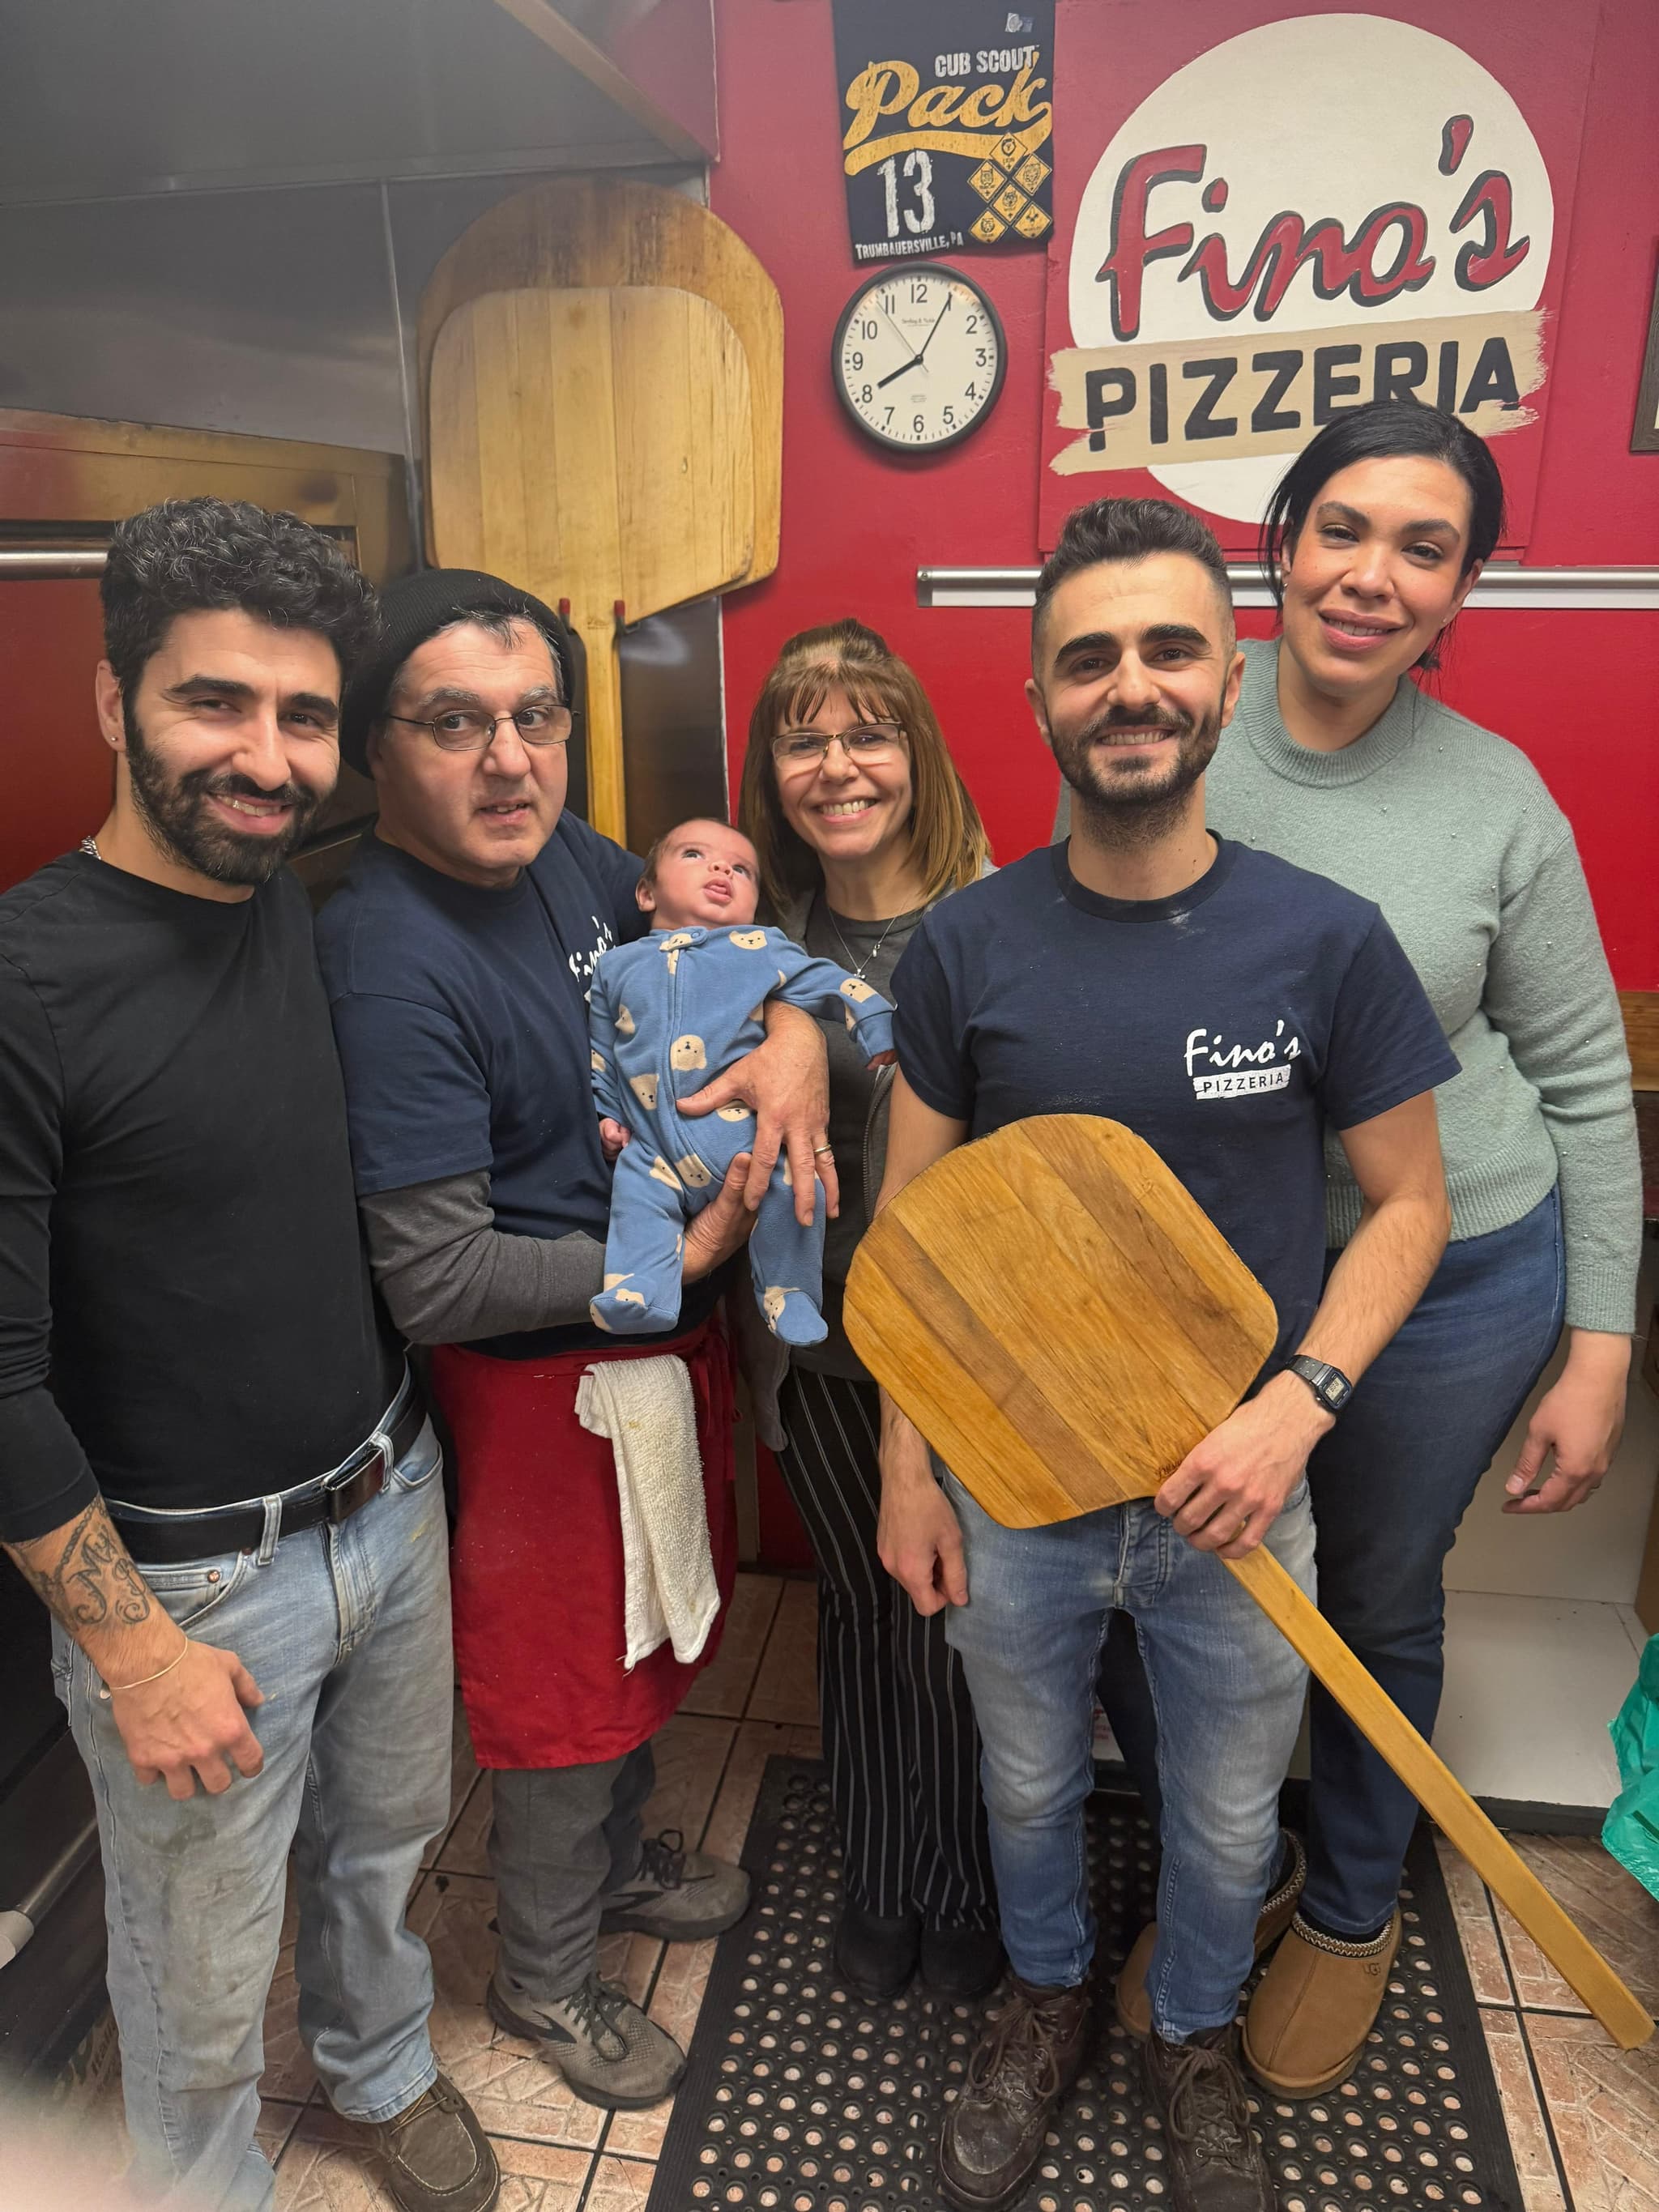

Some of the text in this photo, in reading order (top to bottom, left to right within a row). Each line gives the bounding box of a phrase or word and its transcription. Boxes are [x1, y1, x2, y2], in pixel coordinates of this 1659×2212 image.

[935, 45, 1035, 78] CUB SCOUT
[842, 51, 1052, 151] Pack
[877, 150, 936, 238] 13
[1095, 114, 1531, 342] Fino's
[950, 231, 964, 246] PA
[911, 283, 928, 304] 12
[885, 295, 895, 314] 11
[861, 321, 878, 340] 10
[966, 315, 978, 335] 2
[852, 352, 864, 371] 9
[975, 348, 987, 367] 3
[861, 384, 873, 403] 8
[965, 382, 976, 401] 4
[1085, 336, 1521, 452] PIZZERIA
[884, 407, 895, 425] 7
[913, 415, 924, 433] 6
[943, 406, 953, 424] 5
[1183, 1019, 1301, 1076] Fino's
[1203, 1072, 1284, 1093] PIZZERIA
